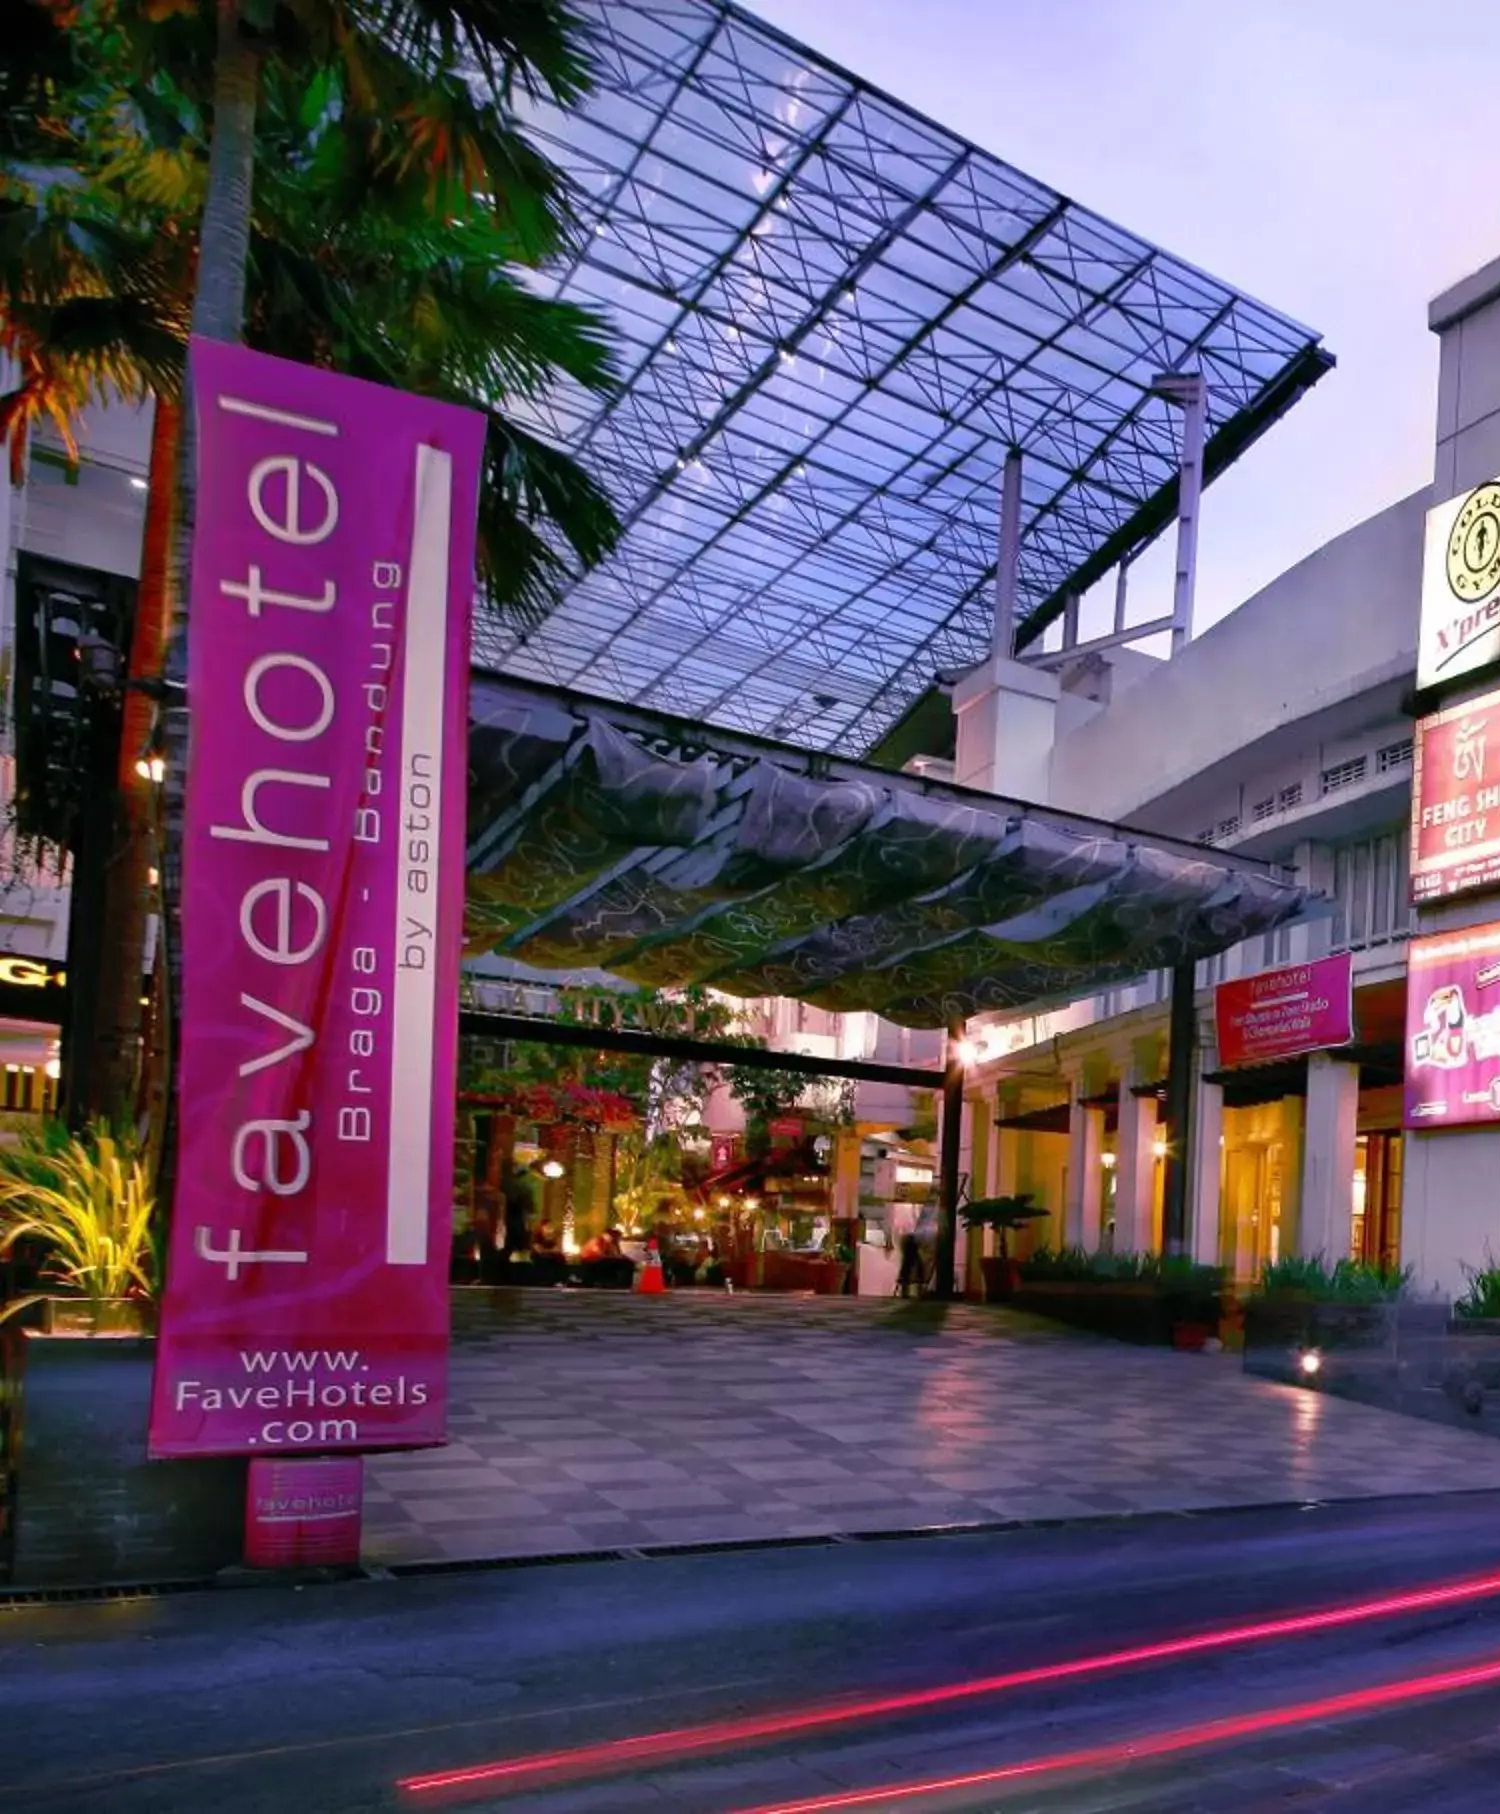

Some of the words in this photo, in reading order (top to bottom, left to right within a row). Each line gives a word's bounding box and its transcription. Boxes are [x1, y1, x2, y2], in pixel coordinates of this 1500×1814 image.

[354, 560, 400, 843] Bandung
[404, 752, 432, 893] aston
[1422, 795, 1470, 829] FENG
[1444, 817, 1487, 847] CITY
[196, 393, 340, 1281] favehotel
[398, 917, 432, 970] by
[338, 945, 382, 1142] Braga
[239, 1351, 369, 1373] www.
[175, 1375, 427, 1411] FaveHotels
[248, 1418, 357, 1444] .com
